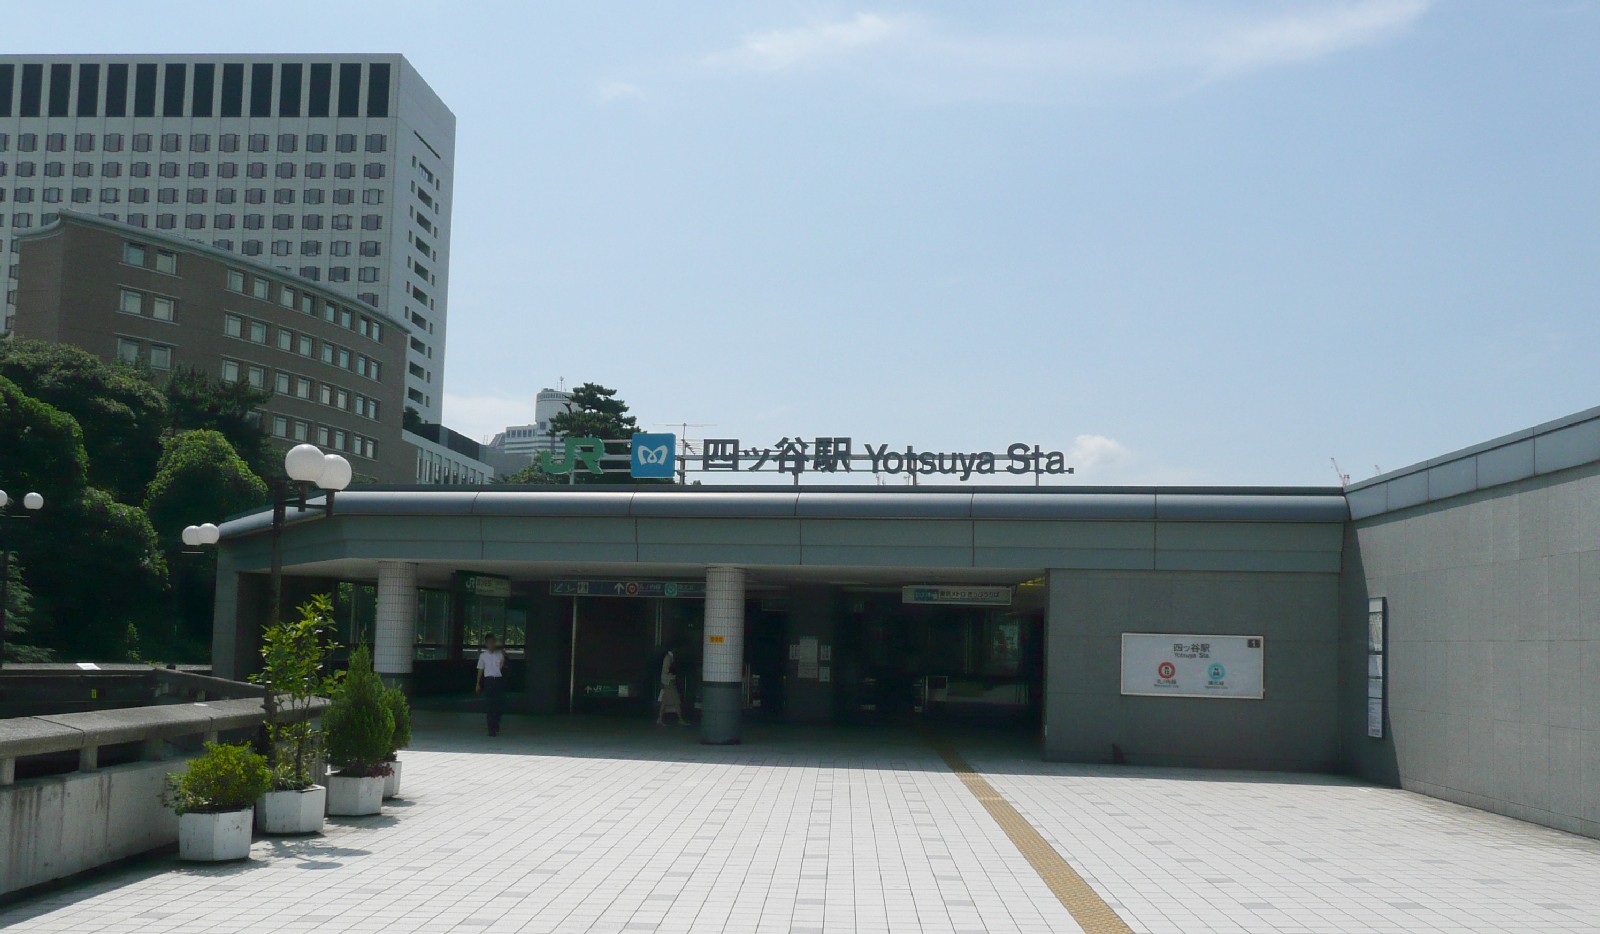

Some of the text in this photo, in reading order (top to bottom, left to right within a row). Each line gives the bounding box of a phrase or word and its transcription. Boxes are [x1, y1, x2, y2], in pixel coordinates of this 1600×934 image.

[542, 437, 605, 475] JR
[864, 442, 1074, 481] Yotsuya Sta.
